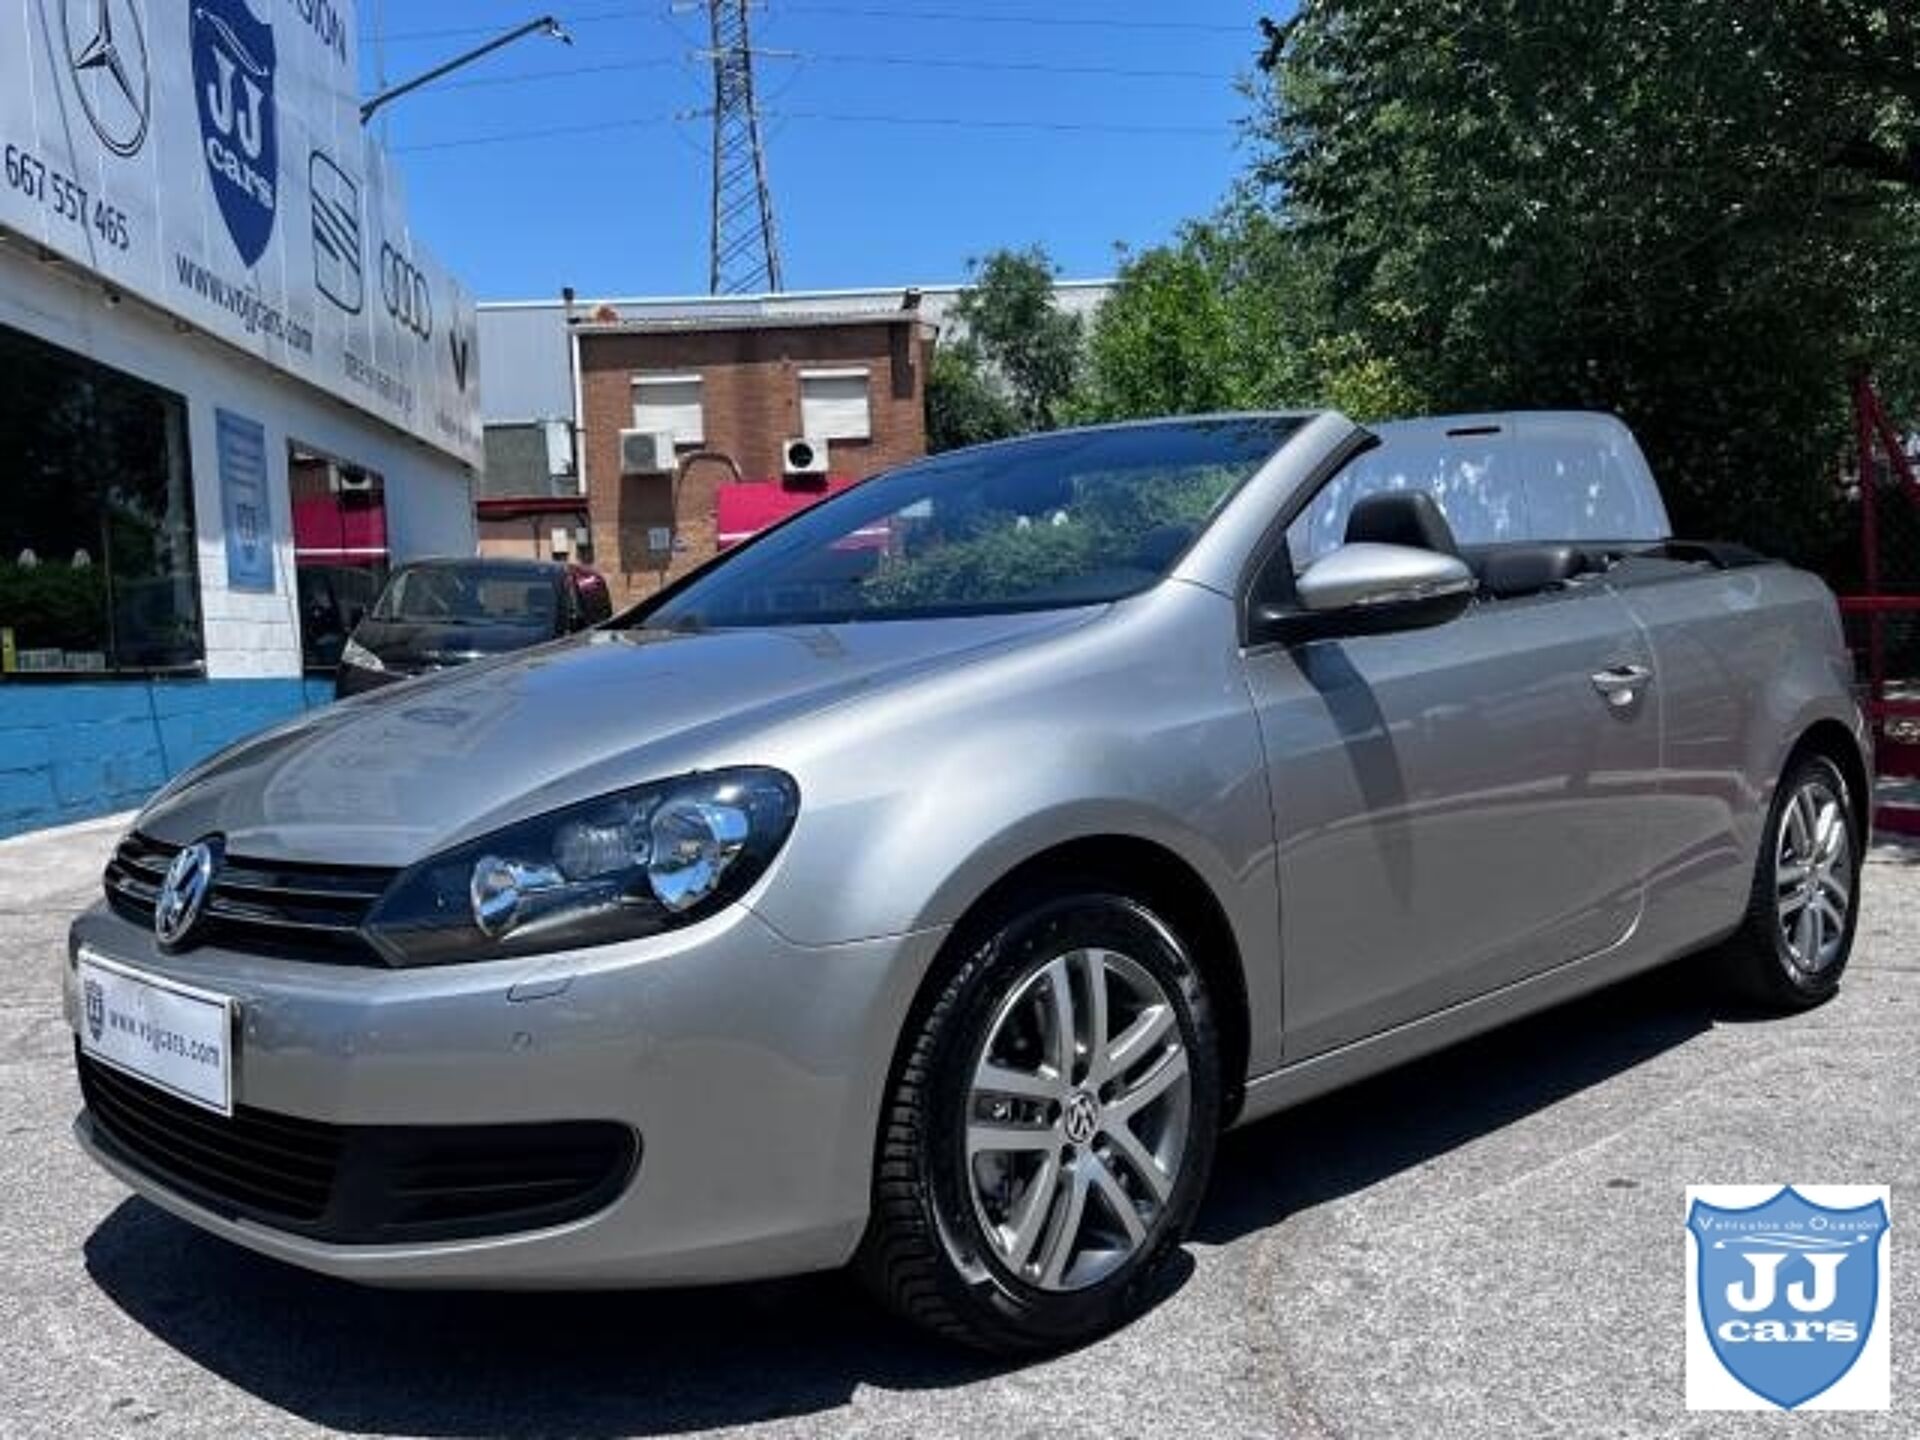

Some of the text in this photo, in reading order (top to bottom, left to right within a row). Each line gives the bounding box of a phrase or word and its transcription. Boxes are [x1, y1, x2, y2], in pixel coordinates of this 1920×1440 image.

[207, 44, 264, 160] JJ
[5, 144, 130, 250] 667 557 465
[207, 137, 273, 210] cars
